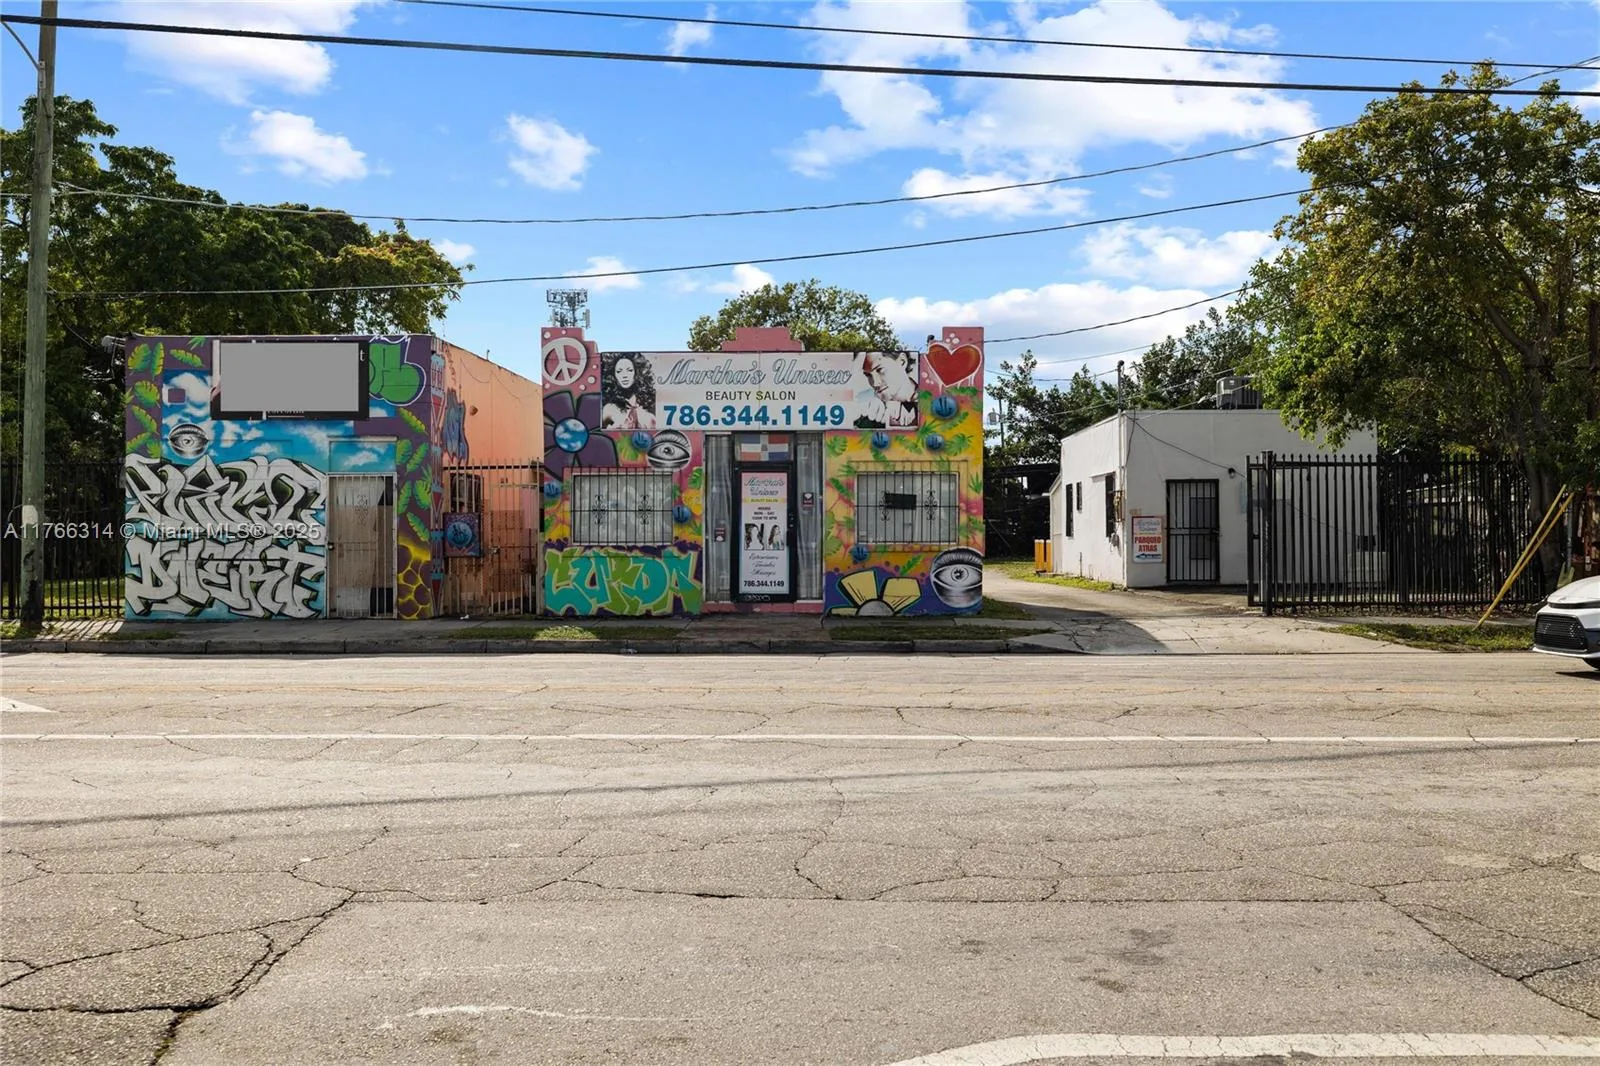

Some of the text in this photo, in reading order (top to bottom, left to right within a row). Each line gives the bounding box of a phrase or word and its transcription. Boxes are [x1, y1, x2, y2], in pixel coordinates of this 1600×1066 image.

[657, 358, 852, 385] Martha's Unisex
[705, 390, 796, 401] BEAUTY SALON
[663, 405, 845, 426] 786.344.1149
